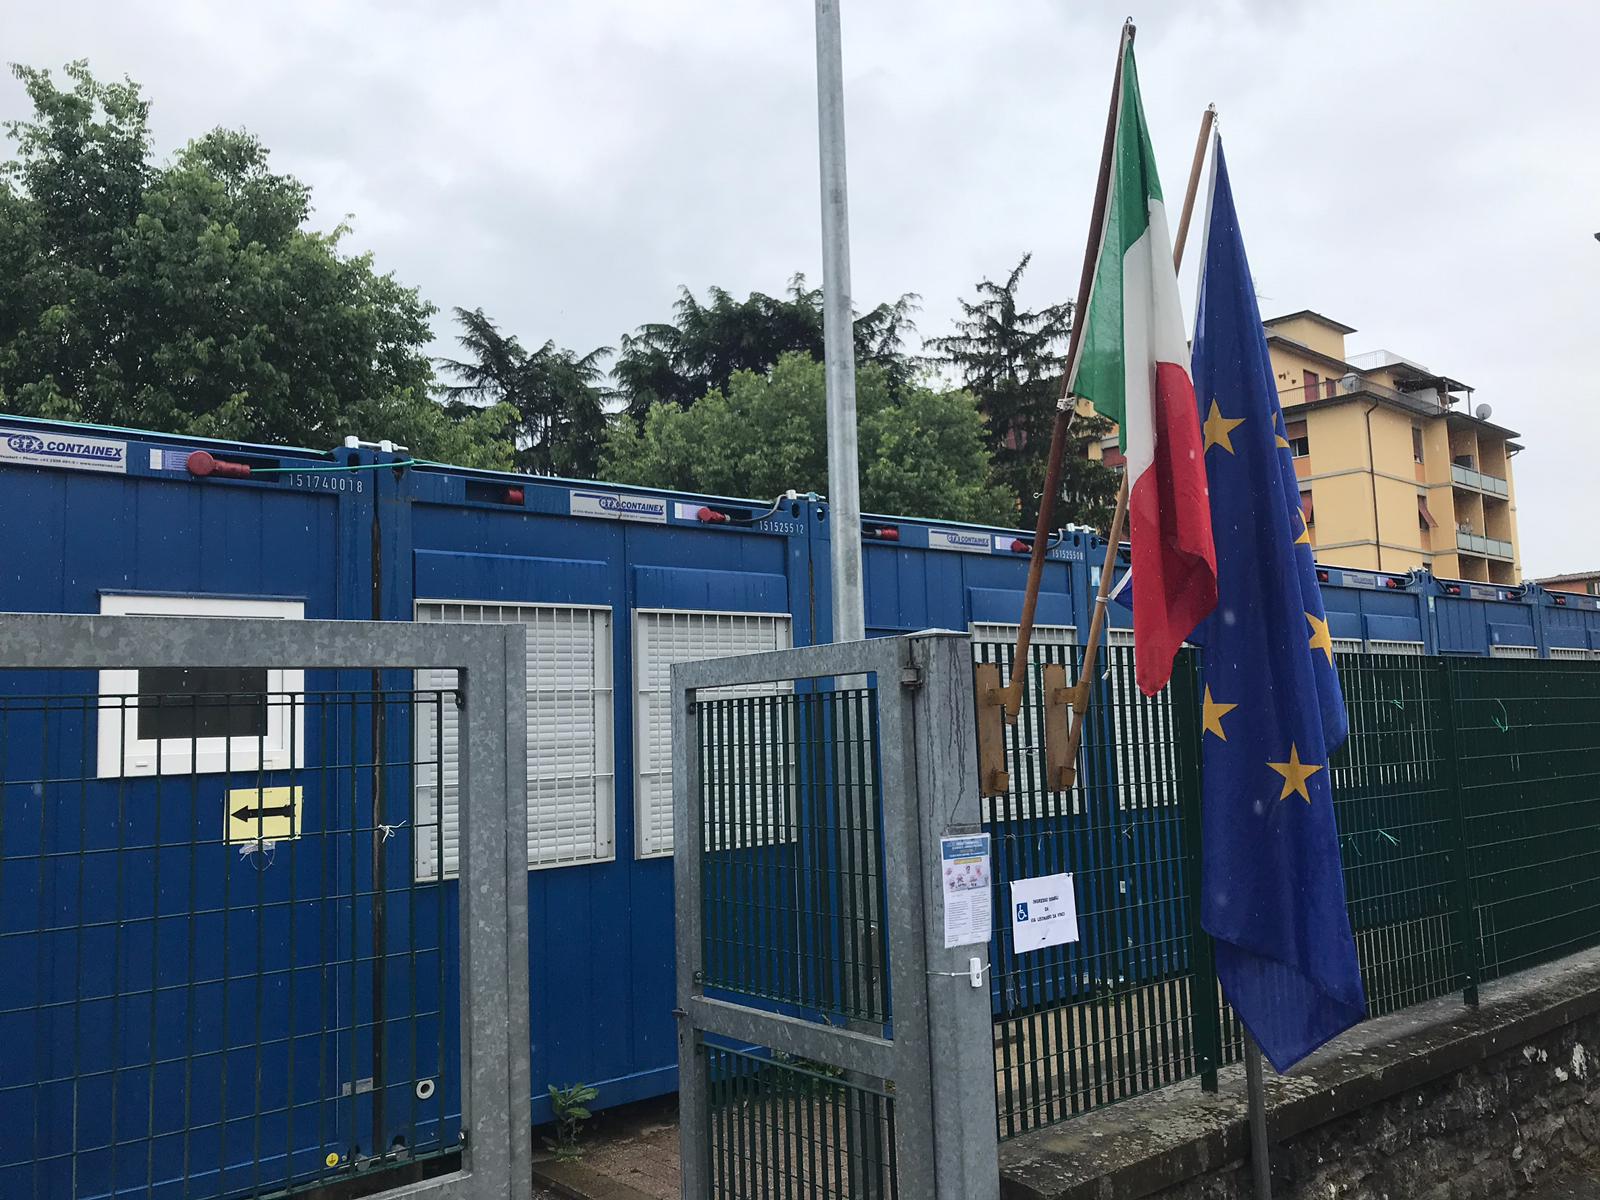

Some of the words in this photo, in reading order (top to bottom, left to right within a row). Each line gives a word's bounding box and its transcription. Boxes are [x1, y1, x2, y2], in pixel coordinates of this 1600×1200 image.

[9, 437, 42, 451] CTX
[46, 441, 123, 457] CONTAINEX
[289, 473, 363, 493] 151740018
[620, 501, 664, 512] CONTAINEX
[759, 520, 804, 534] 151525512
